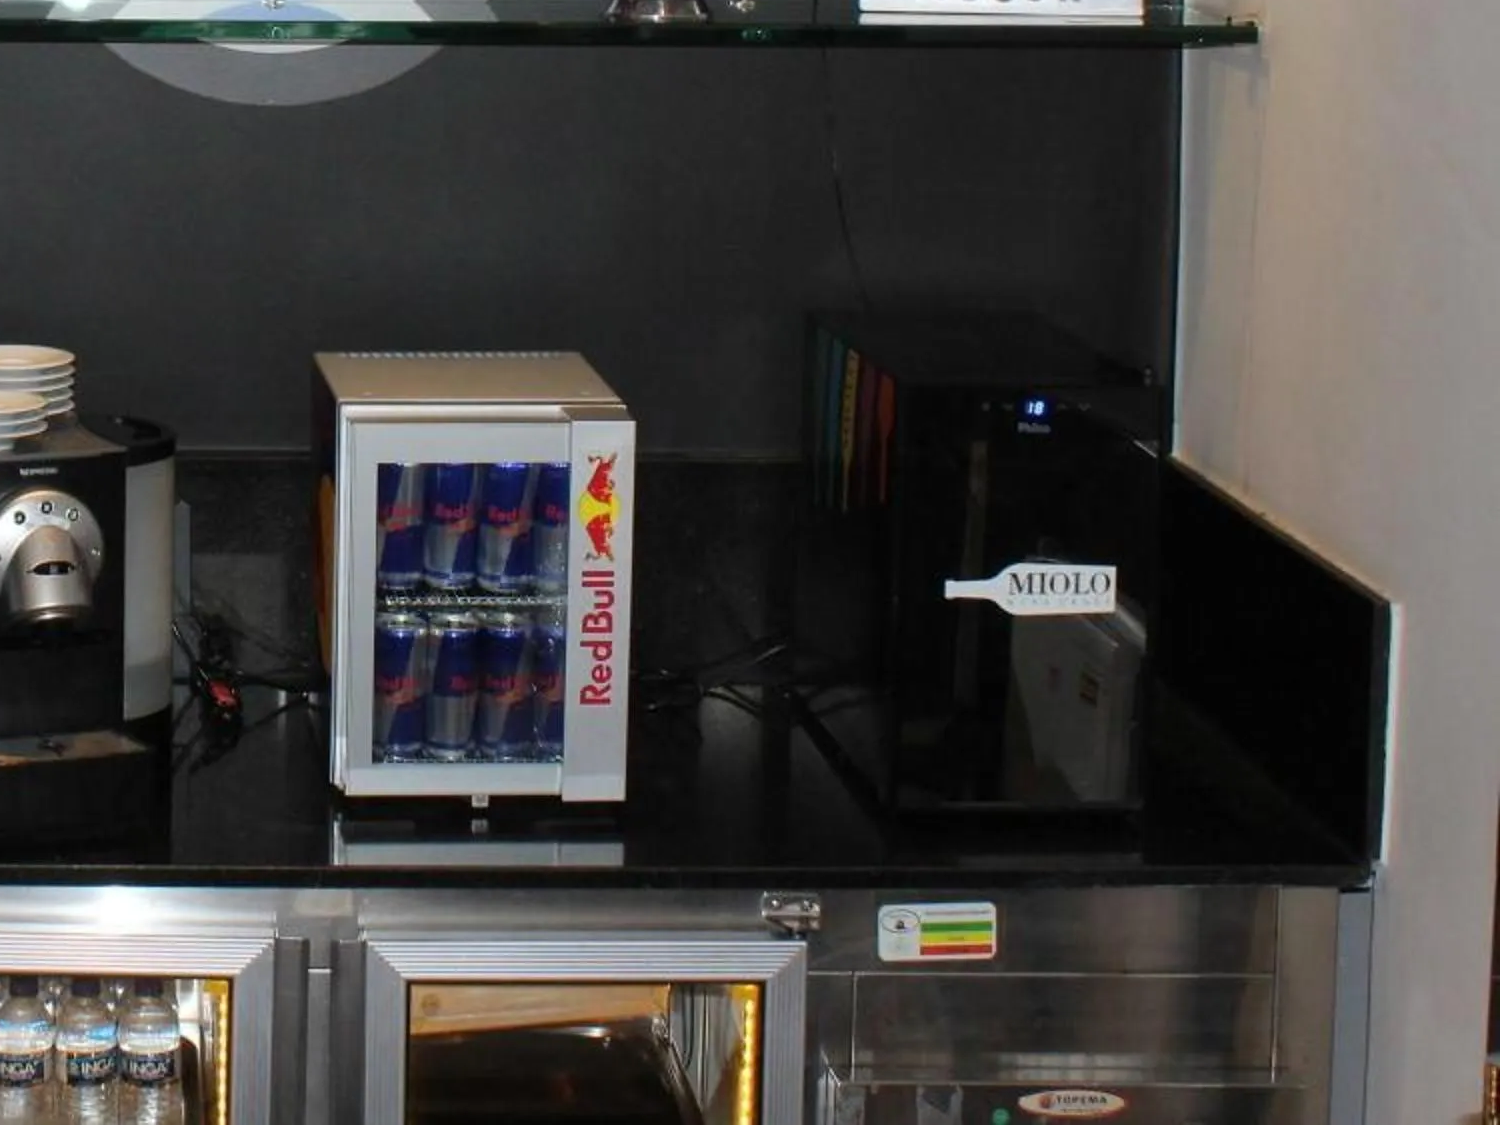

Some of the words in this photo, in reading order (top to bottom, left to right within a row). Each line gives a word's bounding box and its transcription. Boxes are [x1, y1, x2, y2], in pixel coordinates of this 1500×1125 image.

[581, 570, 615, 633] Bull
[1008, 572, 1111, 595] MIOLO
[579, 640, 613, 705] Red
